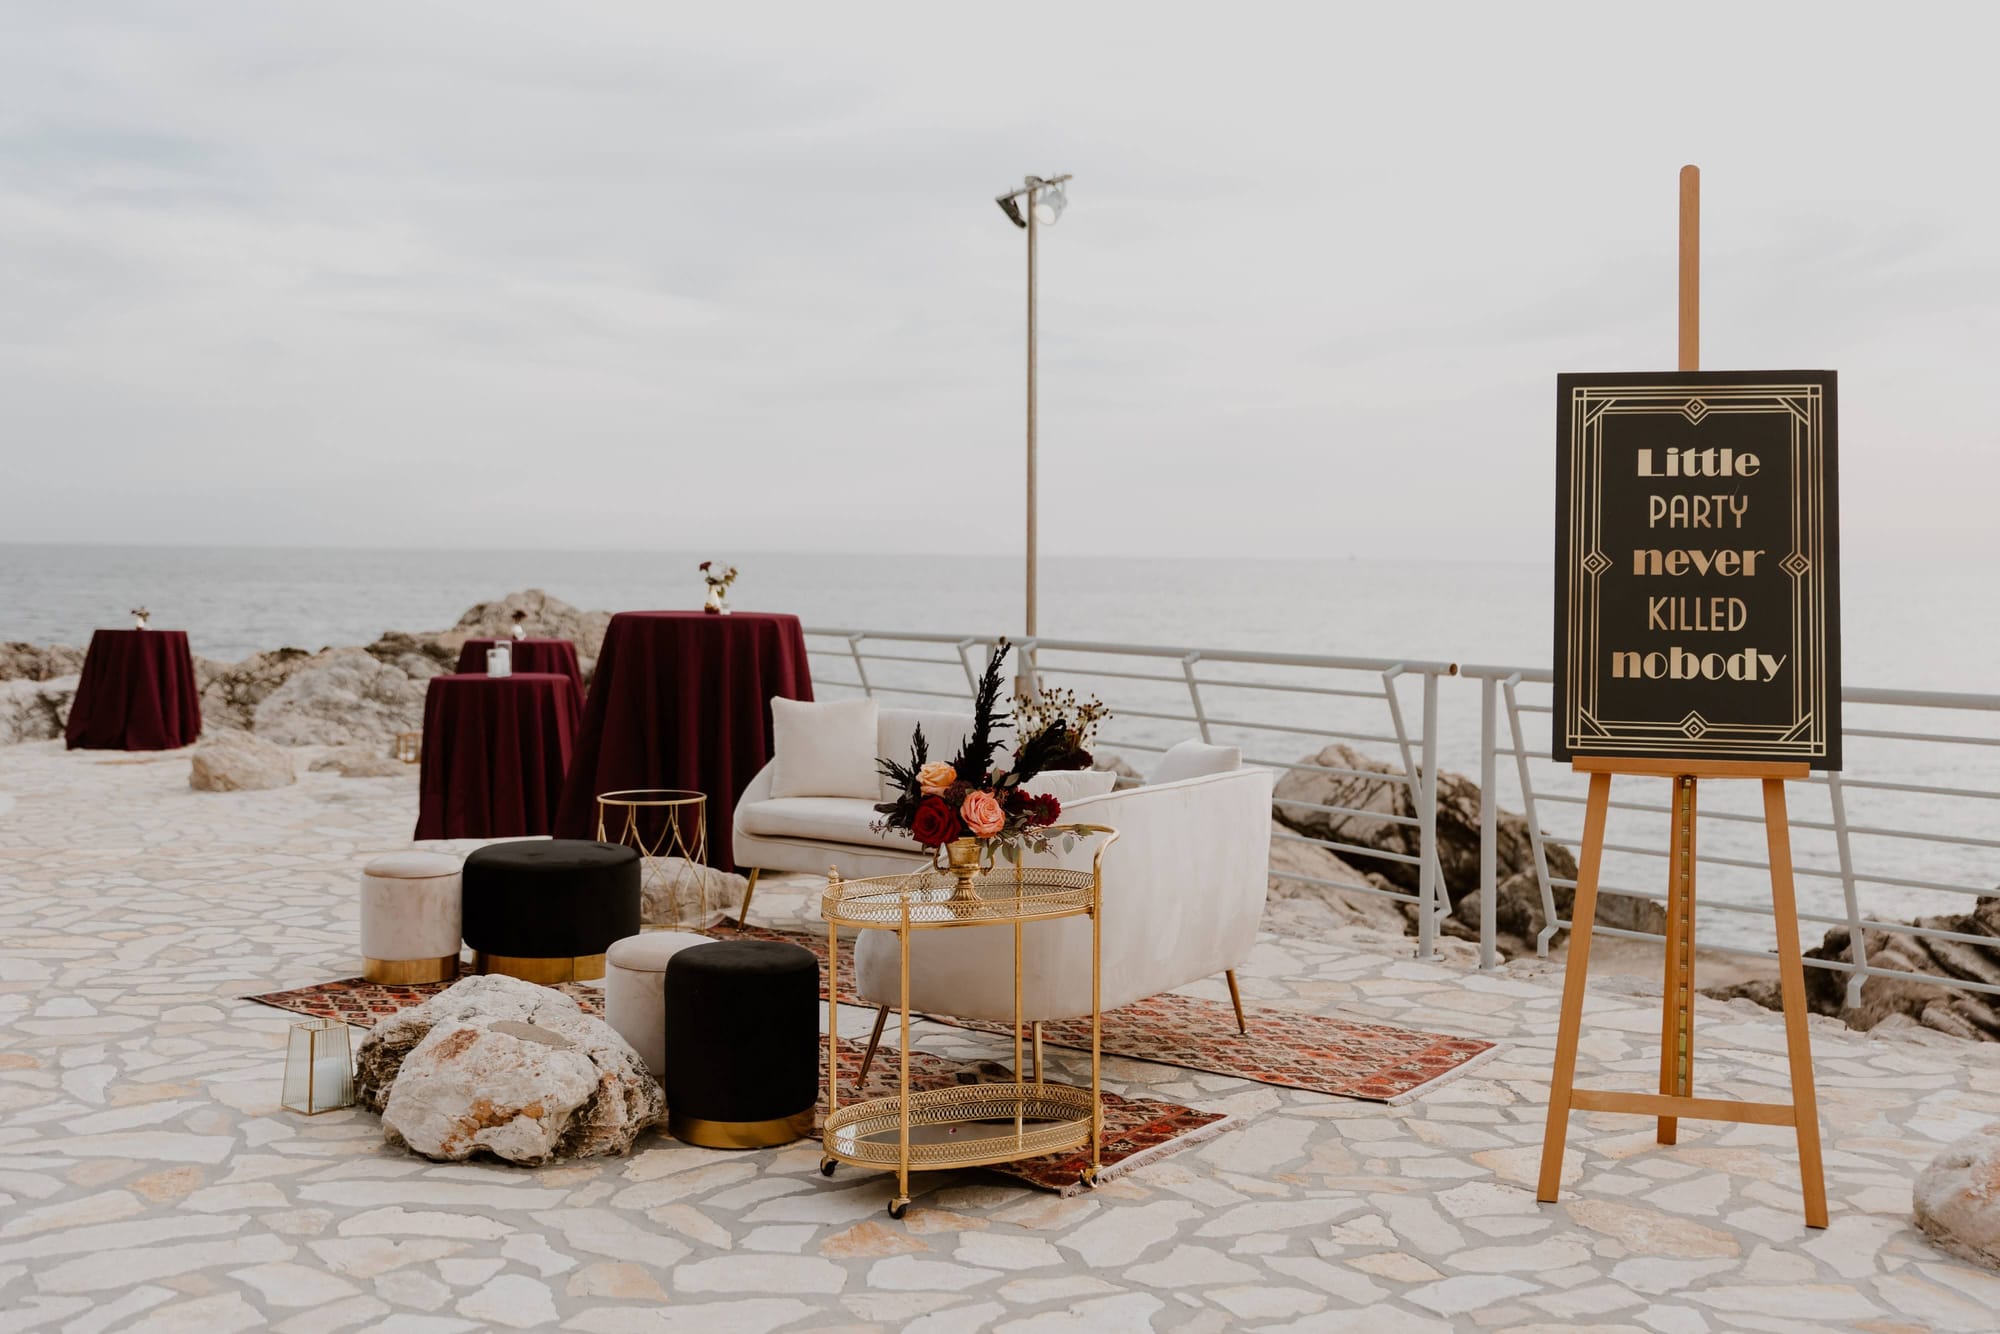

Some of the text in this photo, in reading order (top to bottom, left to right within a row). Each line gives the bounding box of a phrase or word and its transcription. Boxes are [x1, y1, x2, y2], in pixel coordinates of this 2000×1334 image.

[1637, 447, 1760, 477] Little
[1649, 495, 1748, 529] PARTY
[1633, 549, 1766, 577] never
[1648, 596, 1747, 632] KILLED
[1612, 646, 1787, 683] nobody
